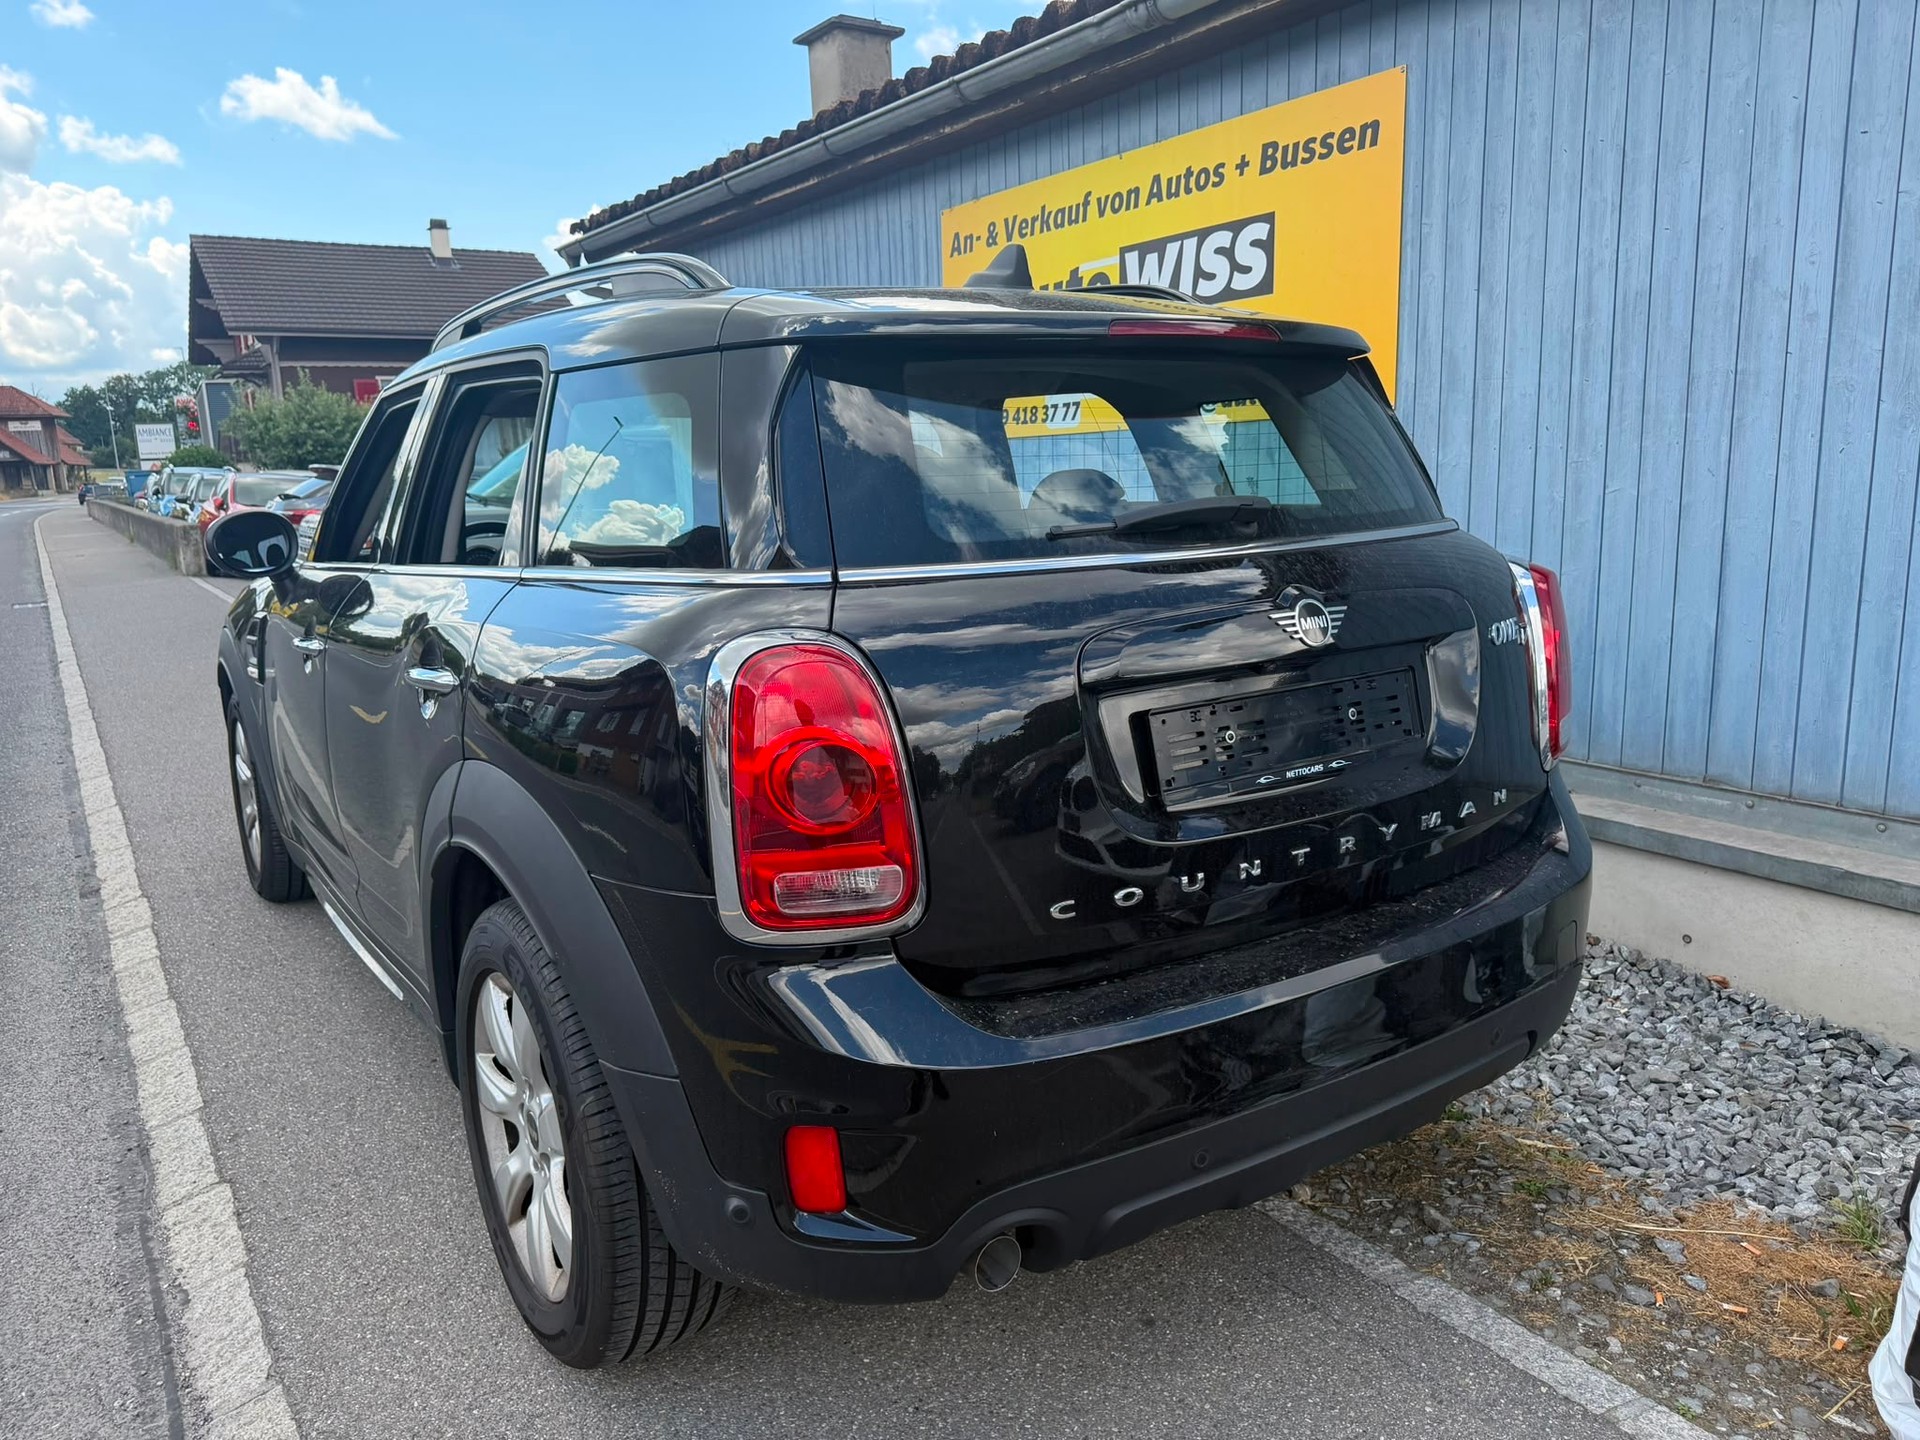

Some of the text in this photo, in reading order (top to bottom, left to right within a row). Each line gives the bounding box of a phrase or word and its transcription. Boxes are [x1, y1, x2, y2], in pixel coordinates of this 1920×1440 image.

[950, 118, 1381, 258] An- & Verkauf von Autos + Bussen
[1124, 222, 1270, 297] WISS
[1012, 405, 1039, 425] 418
[1041, 403, 1060, 423] 37
[1062, 400, 1081, 422] 77
[1300, 614, 1328, 631] MINI
[1286, 764, 1324, 779] NETTOCARS
[1049, 787, 1508, 921] COUNTRYMAN
